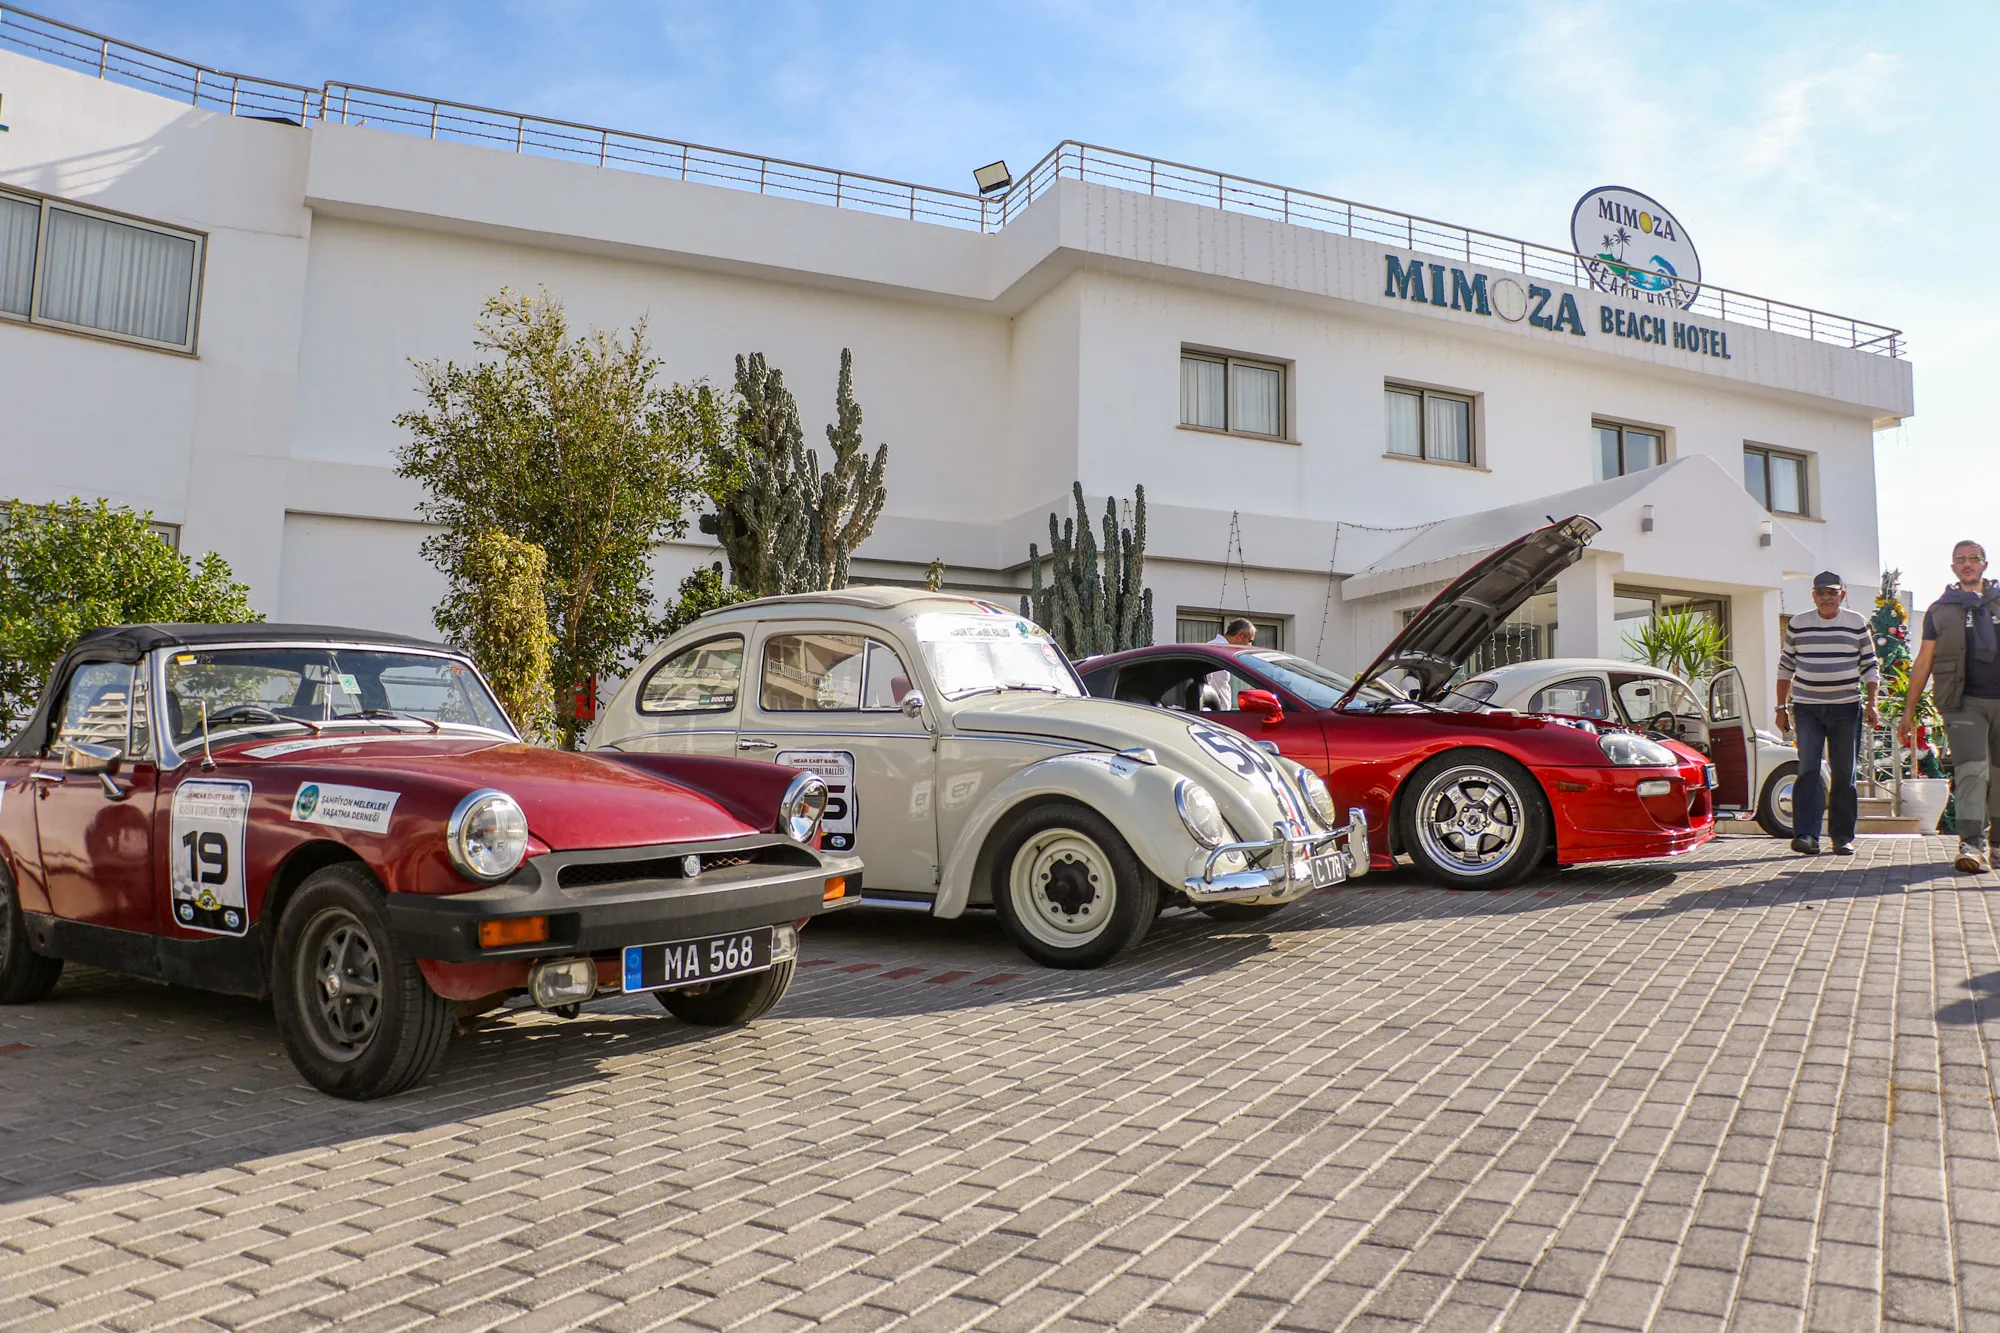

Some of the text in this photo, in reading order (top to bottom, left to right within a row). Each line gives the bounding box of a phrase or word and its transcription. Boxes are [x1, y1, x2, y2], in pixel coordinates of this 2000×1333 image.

[1598, 197, 1677, 243] MIMOZA
[1385, 254, 1731, 359] MIMOZA BEACH HOTEL
[1103, 760, 1128, 772] BANK
[321, 795, 390, 812] ŞAMPİYON MELEKLERİ
[323, 807, 351, 819] YAŞATMA
[183, 830, 229, 885] 19
[1314, 855, 1342, 882] C 178
[664, 935, 753, 981] MA 568
